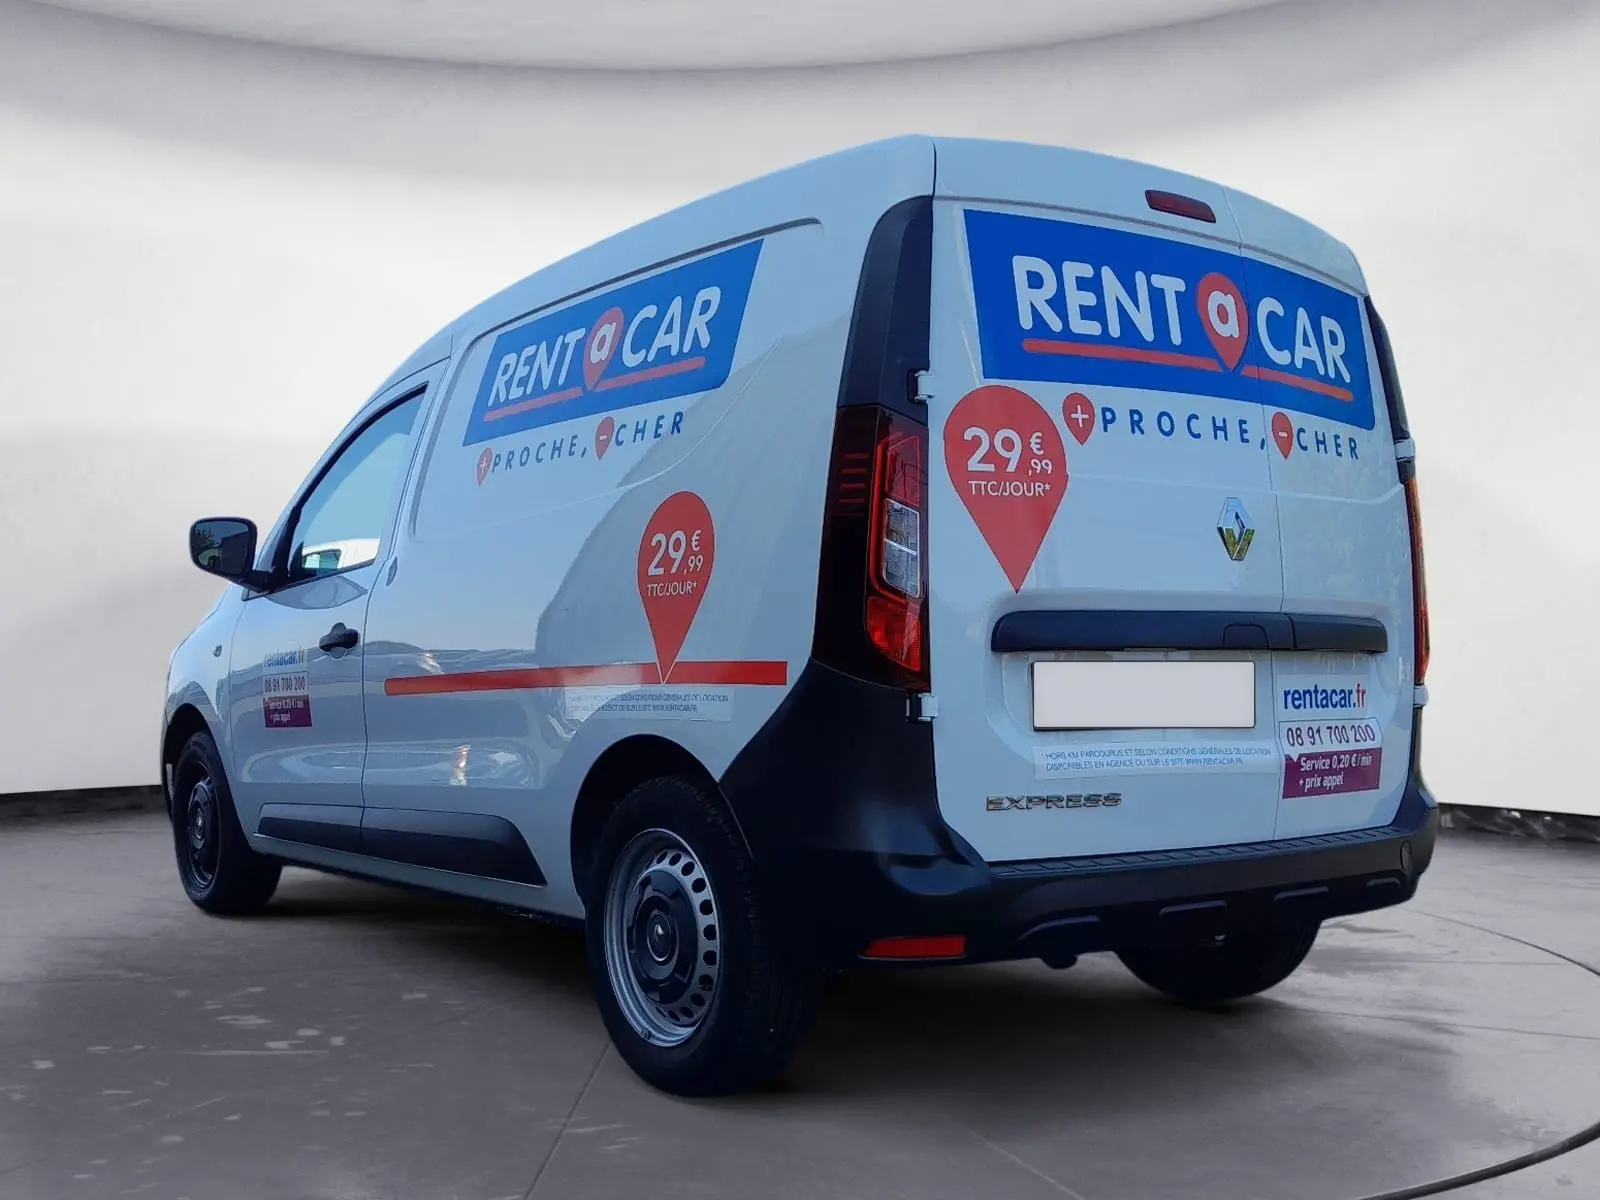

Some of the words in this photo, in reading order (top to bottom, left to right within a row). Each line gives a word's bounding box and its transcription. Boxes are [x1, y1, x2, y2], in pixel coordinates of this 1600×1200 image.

[1012, 255, 1186, 346] RENT
[1207, 289, 1240, 339] a
[1256, 296, 1351, 383] CAR
[487, 327, 586, 407] RENT
[589, 322, 616, 364] a
[621, 286, 721, 367] CAR
[492, 435, 588, 474] PROCHE,
[615, 411, 684, 447] CHER
[964, 426, 1023, 472] 29
[1102, 406, 1267, 451] PROCHE,
[1297, 427, 1360, 461] CHER
[647, 530, 687, 576] 29
[1283, 683, 1367, 709] rentacar.fr
[1286, 727, 1304, 747] 08
[1307, 726, 1324, 746] 91
[1326, 725, 1350, 745] 700
[1351, 724, 1376, 743] 200
[1300, 757, 1330, 772] Service
[1332, 754, 1350, 770] 0,20
[1305, 774, 1322, 792] prix
[1322, 771, 1344, 791] appel
[985, 793, 1122, 812] EXPRESS
